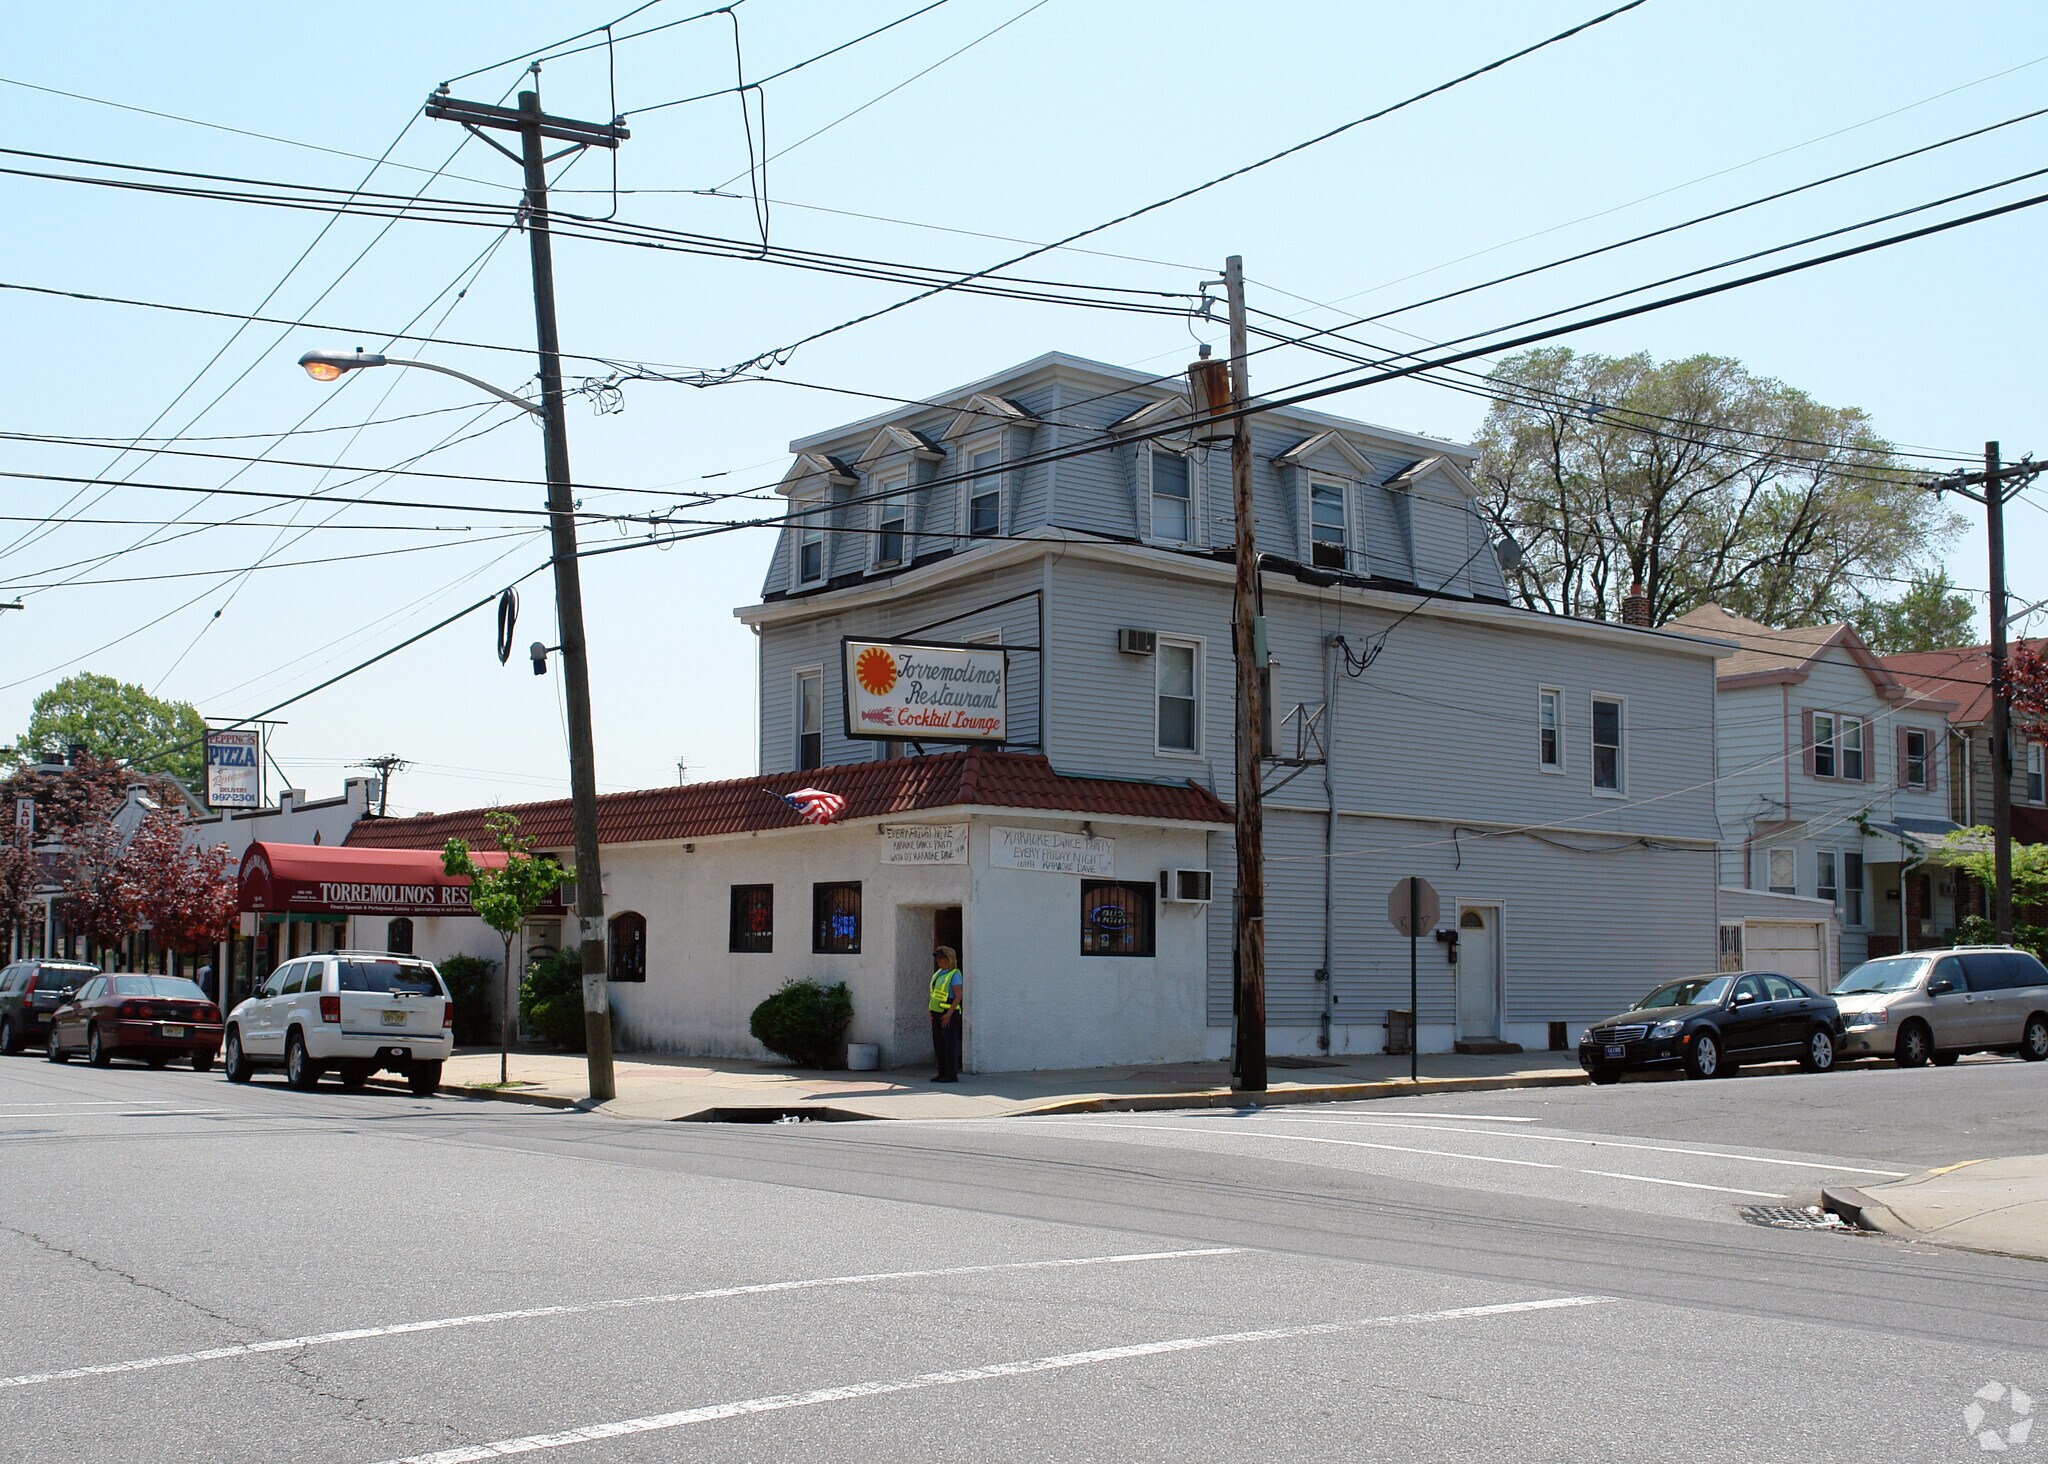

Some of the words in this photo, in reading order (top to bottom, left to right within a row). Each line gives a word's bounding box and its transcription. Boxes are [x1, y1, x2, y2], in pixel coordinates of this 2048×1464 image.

[898, 654, 1001, 685] Torremolinos
[905, 681, 1001, 709] Restaurant
[898, 707, 951, 728] Cocktail
[952, 710, 1000, 735] Lounge
[208, 746, 256, 767] PIZZA
[212, 793, 256, 802] 997-2301
[934, 826, 954, 840] NITE
[1004, 830, 1050, 847] KARAOKE
[1014, 847, 1041, 860] EVERY
[1042, 848, 1070, 862] FRIDAY
[1073, 852, 1104, 866] NIGHT
[320, 882, 434, 904] TORREMOLINO'S
